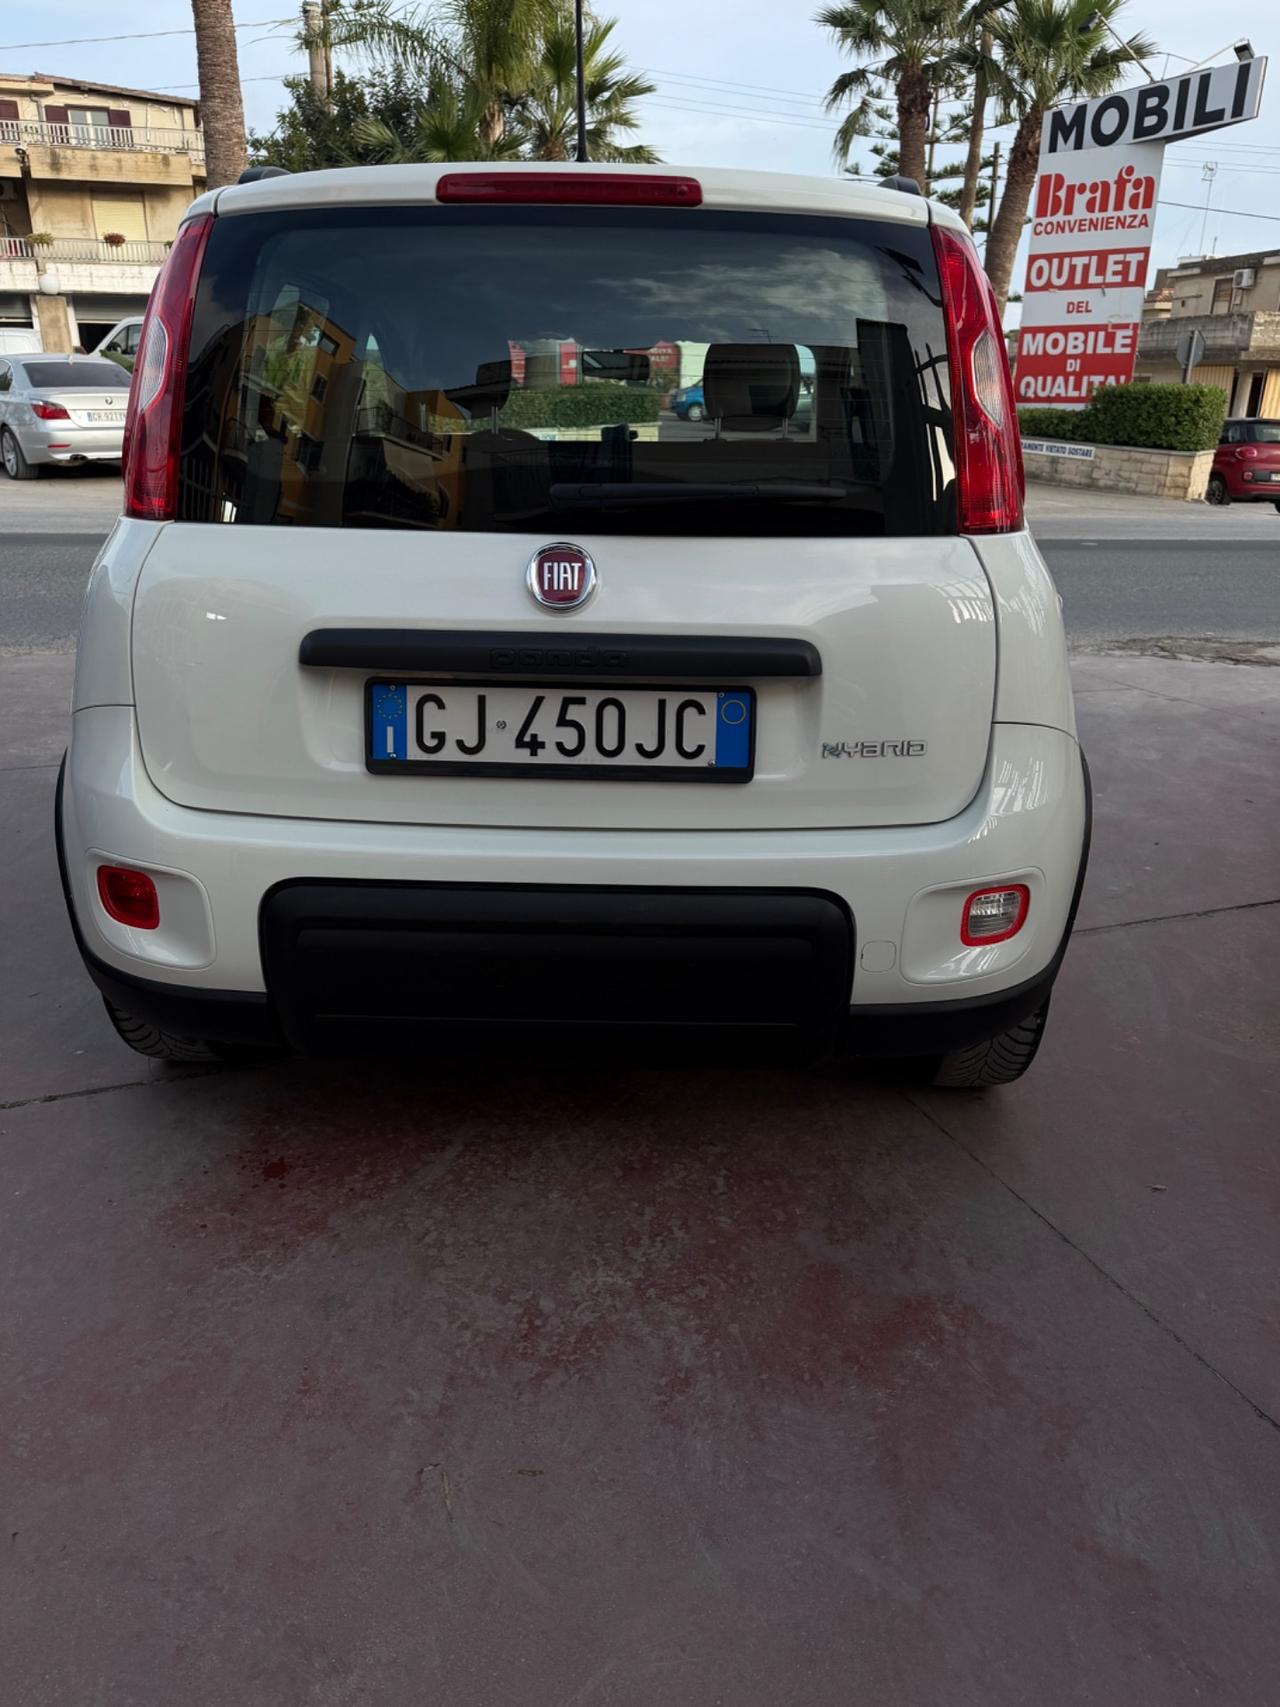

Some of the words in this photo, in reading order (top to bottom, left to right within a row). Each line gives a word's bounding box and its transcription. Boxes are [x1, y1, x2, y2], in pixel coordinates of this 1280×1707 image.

[1048, 62, 1252, 154] MOBILI
[1034, 164, 1156, 219] Brafa
[1033, 213, 1149, 236] CONVENIENZA
[1029, 252, 1144, 288] OUTLET
[1066, 301, 1092, 314] DEL
[1021, 329, 1133, 355] MOBILE
[1066, 359, 1081, 372] DI
[543, 561, 582, 591] FIAT
